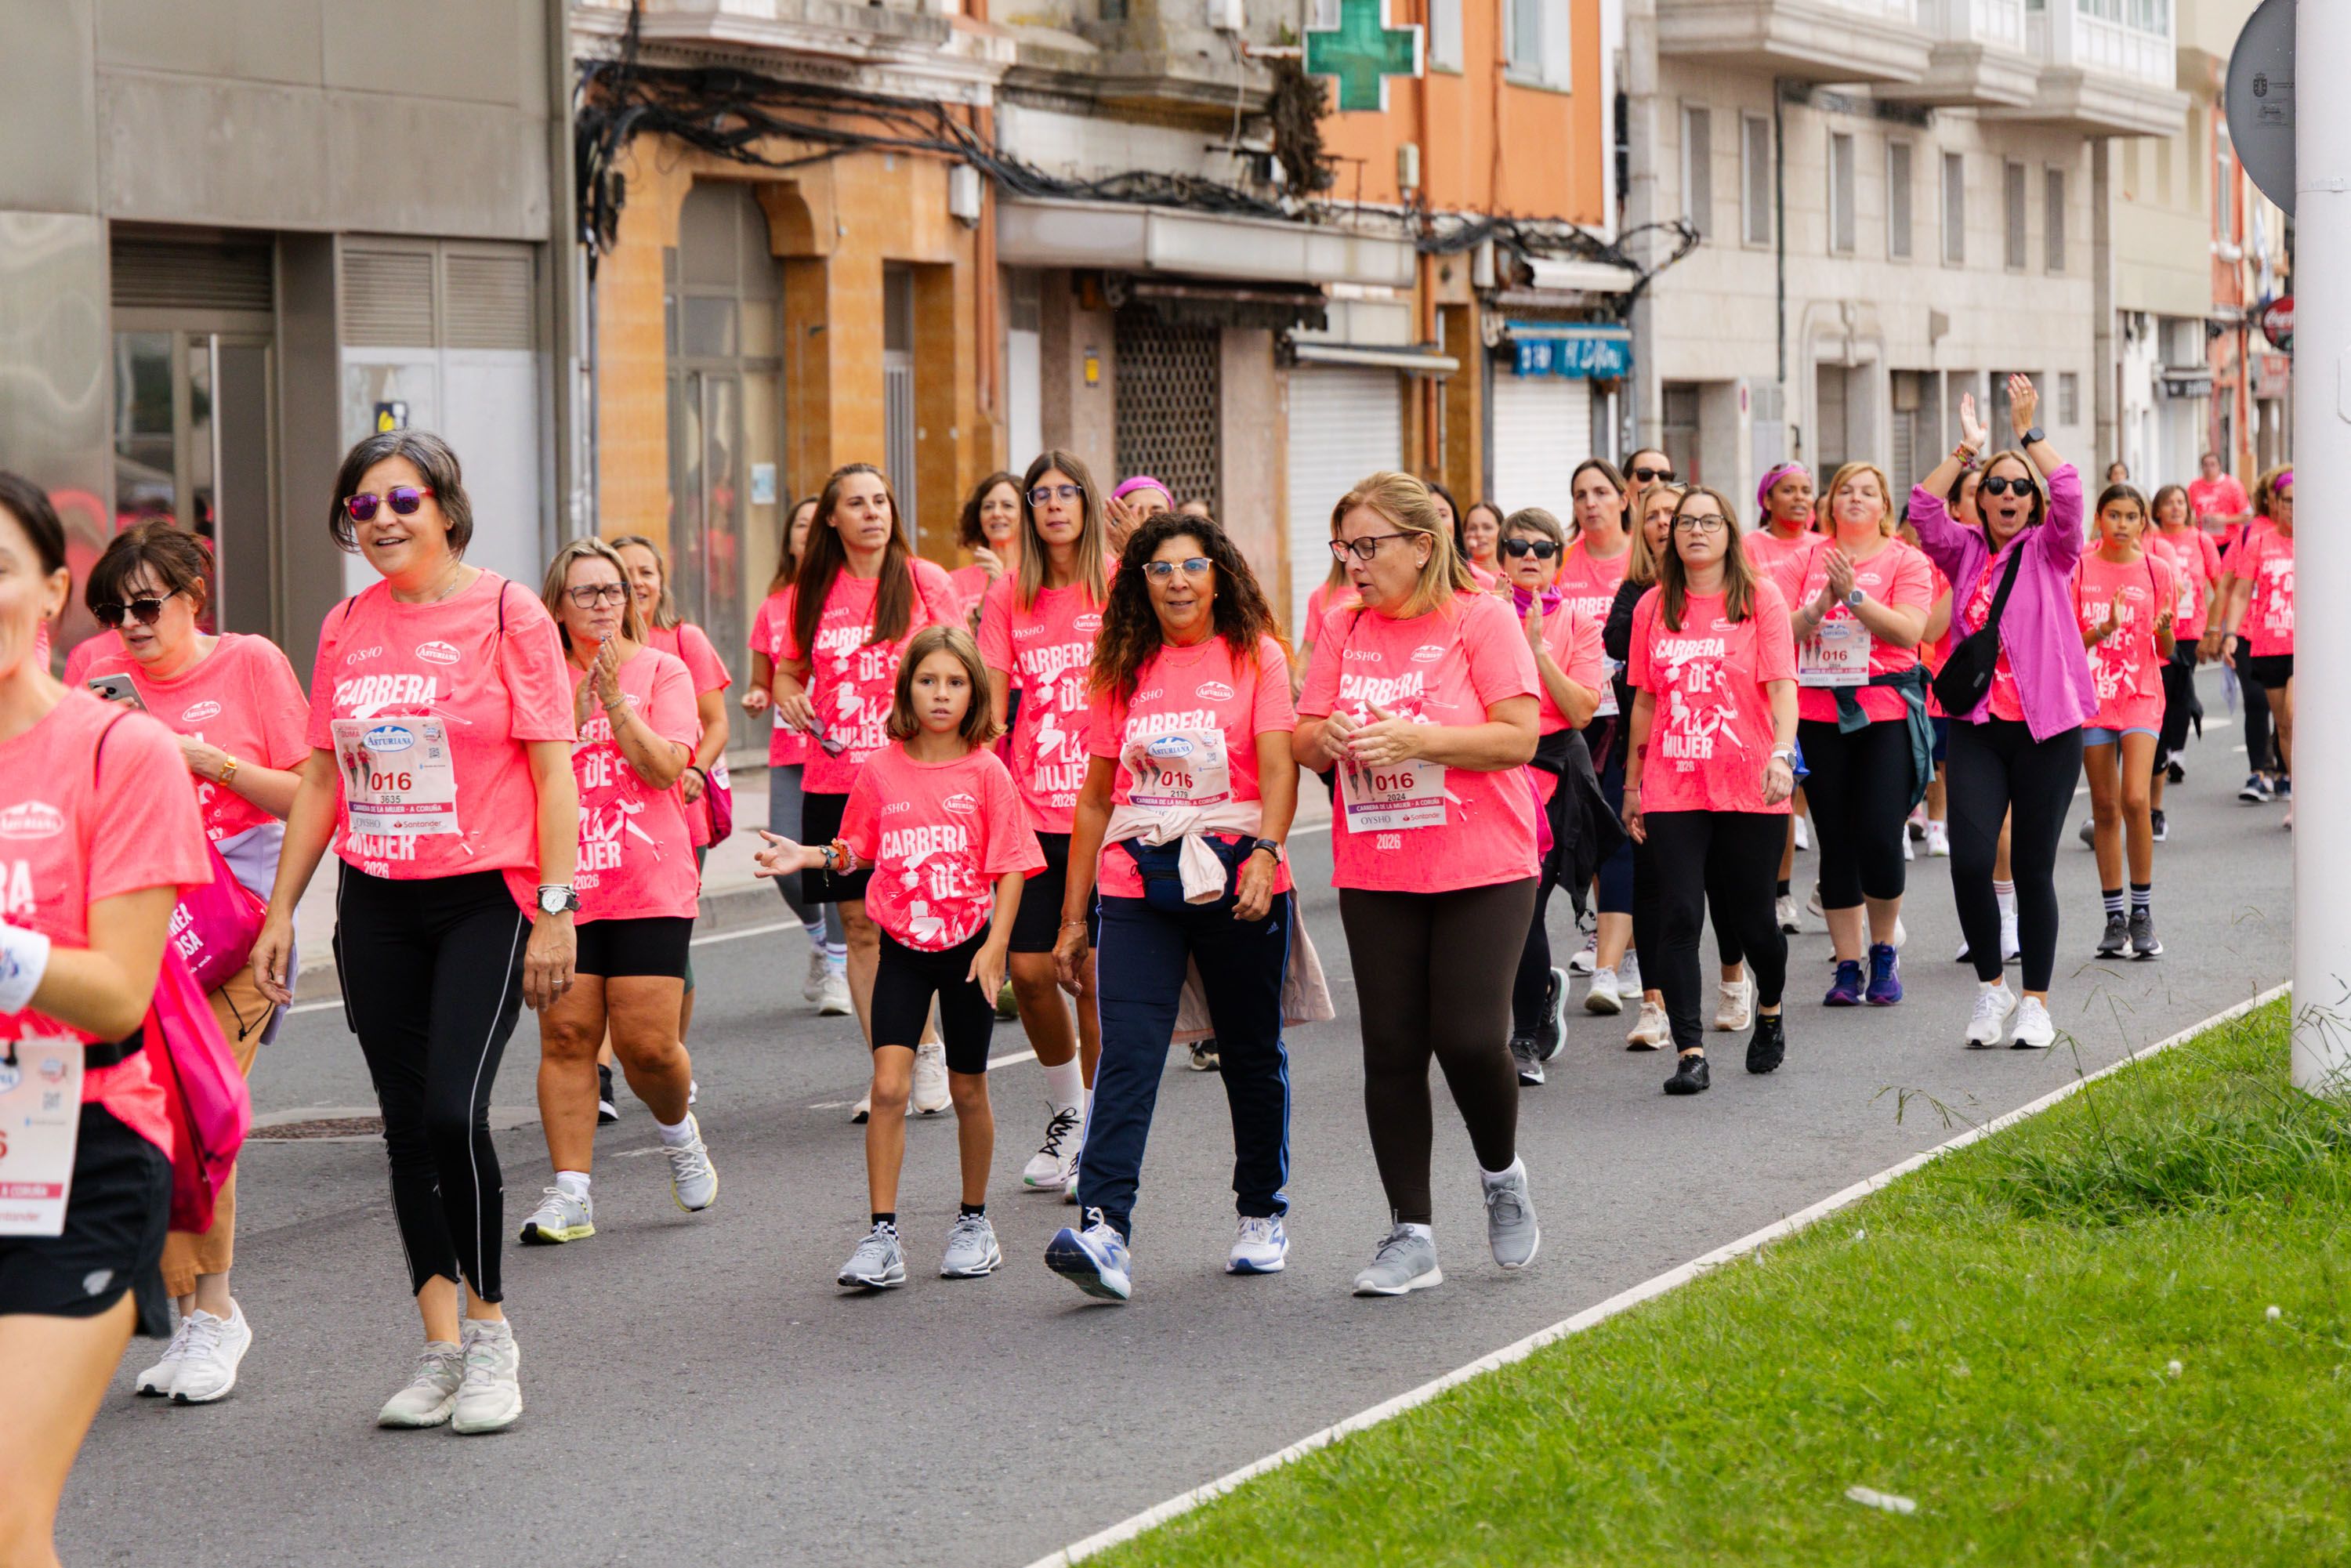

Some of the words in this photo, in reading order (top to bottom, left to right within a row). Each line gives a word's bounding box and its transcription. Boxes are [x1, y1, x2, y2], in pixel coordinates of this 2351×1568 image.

[1012, 624, 1045, 639] OYSHO
[1656, 638, 1726, 659] CARRERA
[1823, 650, 1848, 661] 016
[859, 650, 886, 682] DE
[1339, 670, 1425, 705] CARRERA
[1688, 663, 1712, 693] DE
[332, 673, 437, 707] CARRERA
[1060, 676, 1089, 712] DE
[859, 700, 878, 725] LA
[1125, 708, 1216, 741] CARRERA
[1683, 712, 1704, 736] LA
[368, 735, 411, 747] ASTURIANA
[1060, 733, 1083, 764] LA
[1151, 745, 1190, 756] ASTURIANA
[1662, 733, 1714, 759] MUJER
[585, 751, 614, 789] DE
[1675, 760, 1696, 773] 2026
[371, 772, 412, 791] 016
[1161, 770, 1194, 789] 016
[1375, 772, 1415, 791] 016
[380, 795, 401, 804] 3635
[1051, 793, 1077, 808] 2026
[1170, 789, 1189, 799] 2179
[1386, 793, 1407, 802] 2024
[416, 804, 442, 813] CORUÑA
[403, 820, 442, 829] Santander
[1360, 815, 1392, 826] OYSHO
[346, 832, 416, 861] MUJER
[881, 824, 969, 861] CARRERA
[1376, 833, 1401, 850] 2026
[364, 860, 389, 879] 2026
[574, 873, 600, 891] 2026
[931, 863, 963, 901] DE
[940, 918, 969, 947] LA
